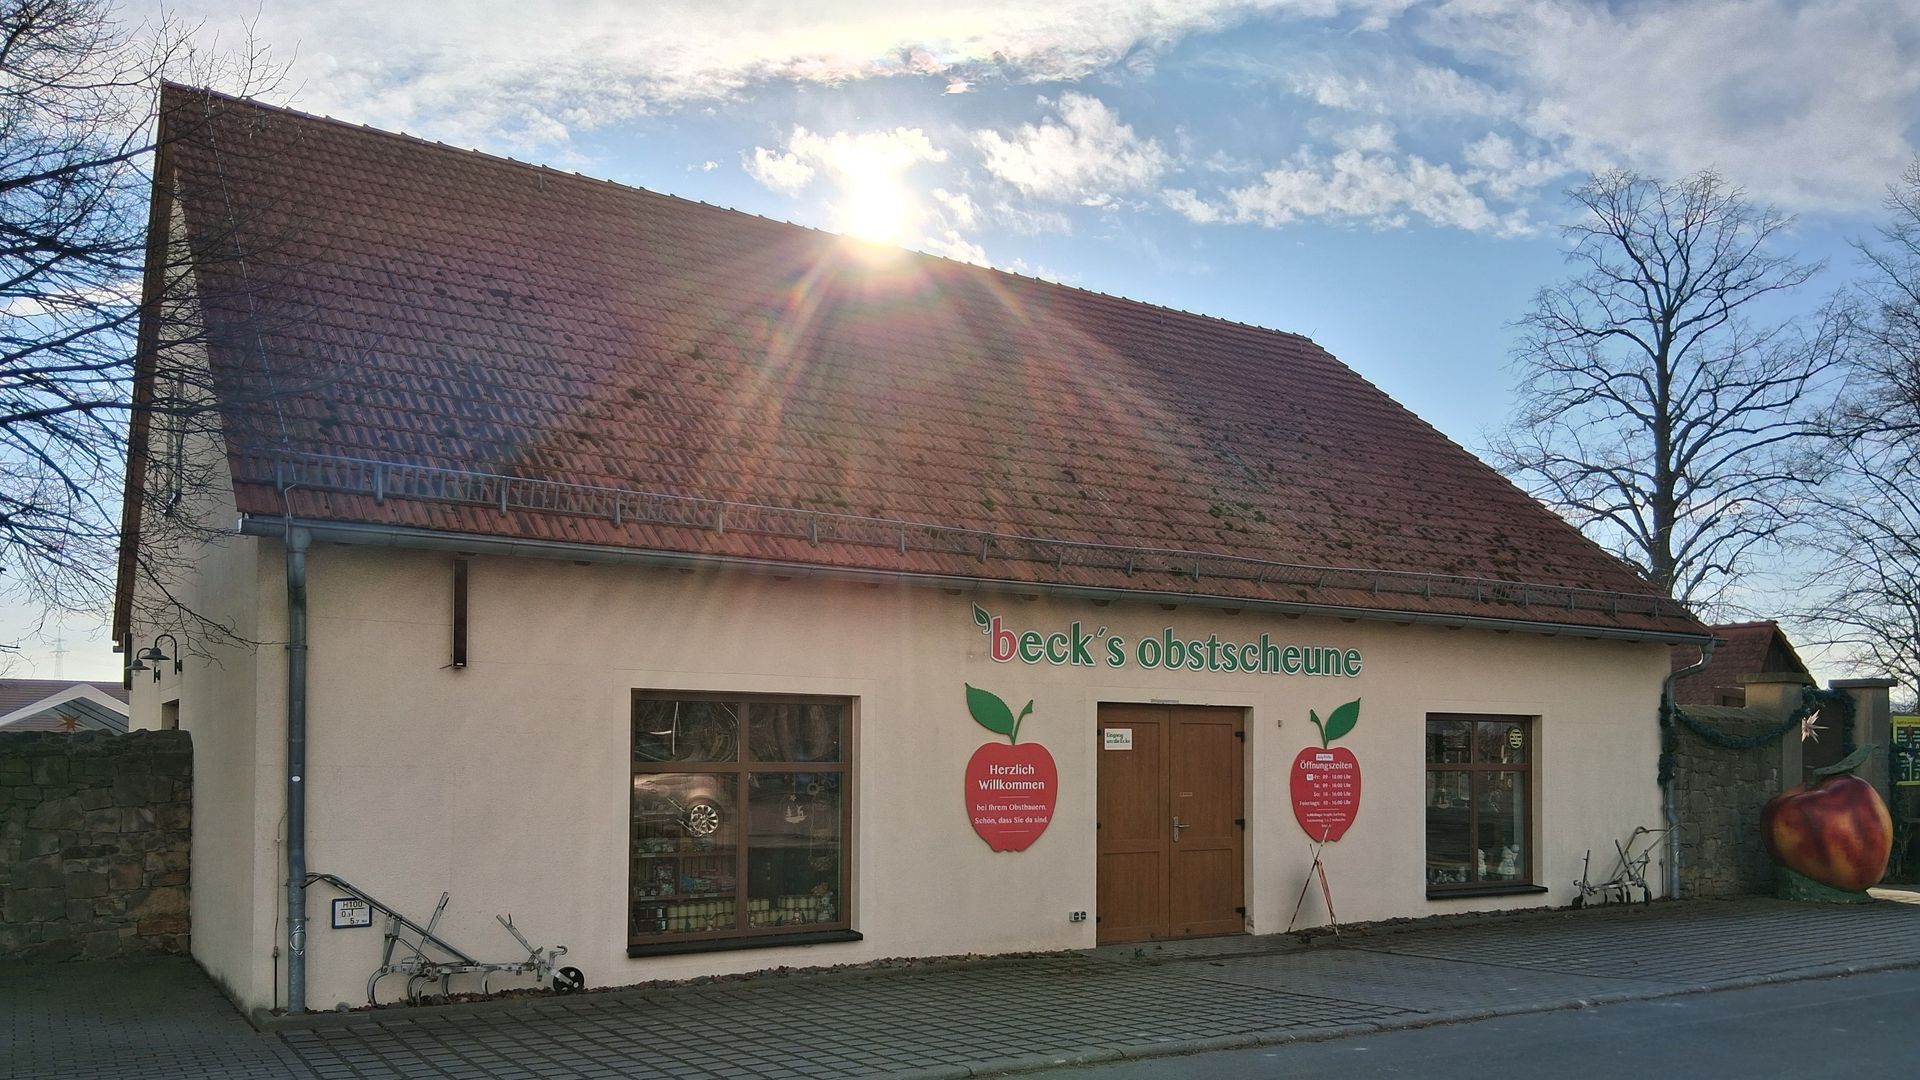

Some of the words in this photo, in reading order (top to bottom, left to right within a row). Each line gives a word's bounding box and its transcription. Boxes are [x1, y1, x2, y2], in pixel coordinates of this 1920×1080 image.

[1136, 626, 1363, 678] obstscheune
[990, 764, 1035, 775] Herzlich
[1300, 760, 1353, 771] Öffnungszeiten
[979, 779, 1045, 790] Willkommen
[998, 816, 1013, 824] dass
